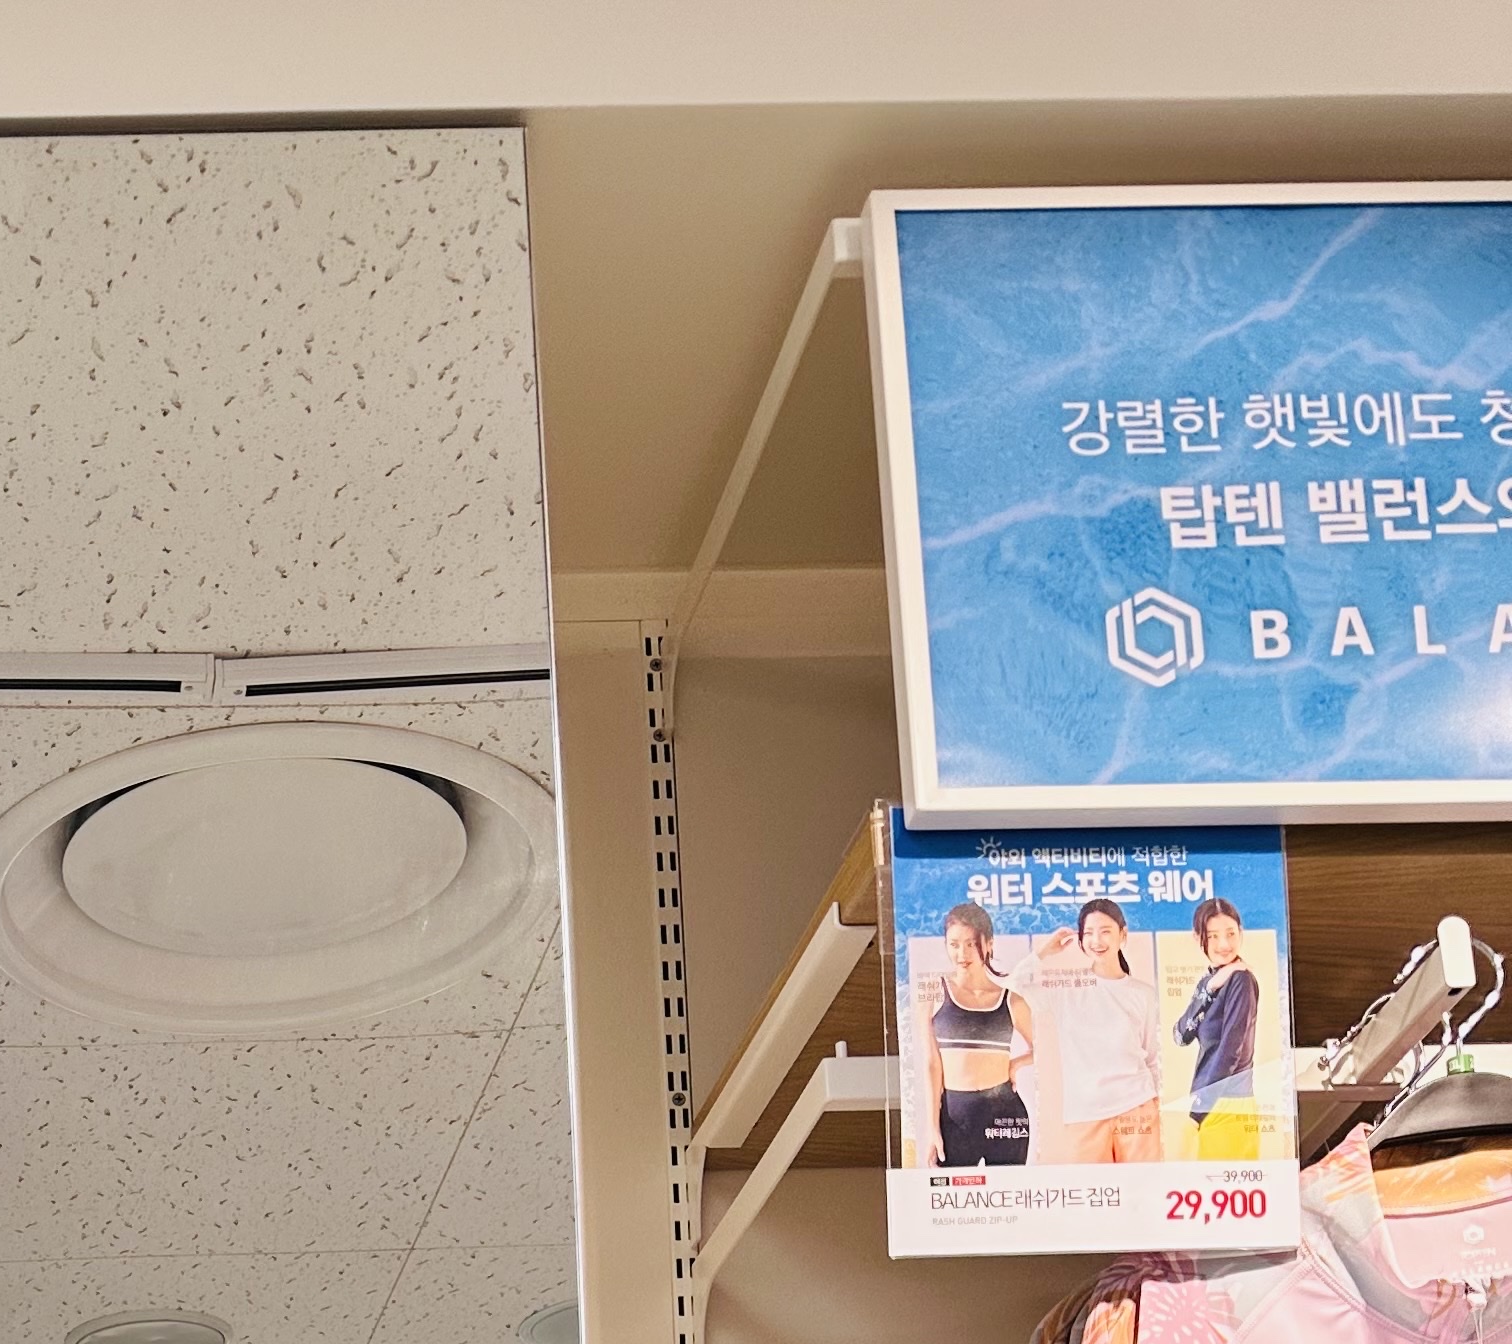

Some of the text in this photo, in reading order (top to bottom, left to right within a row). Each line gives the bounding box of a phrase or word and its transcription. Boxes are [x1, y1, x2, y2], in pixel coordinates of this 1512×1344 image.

[1061, 396, 1225, 456] 강렬한
[1243, 390, 1464, 448] 햇빛에도
[1159, 481, 1287, 549] 탑텐
[1132, 844, 1188, 867] 적합한
[966, 868, 1215, 906] 워터 스포츠 웨어
[1223, 1169, 1263, 1184] 39,900
[931, 1186, 1121, 1210] BALANCE 래쉬가드 집업
[1165, 1189, 1268, 1225] 29,900
